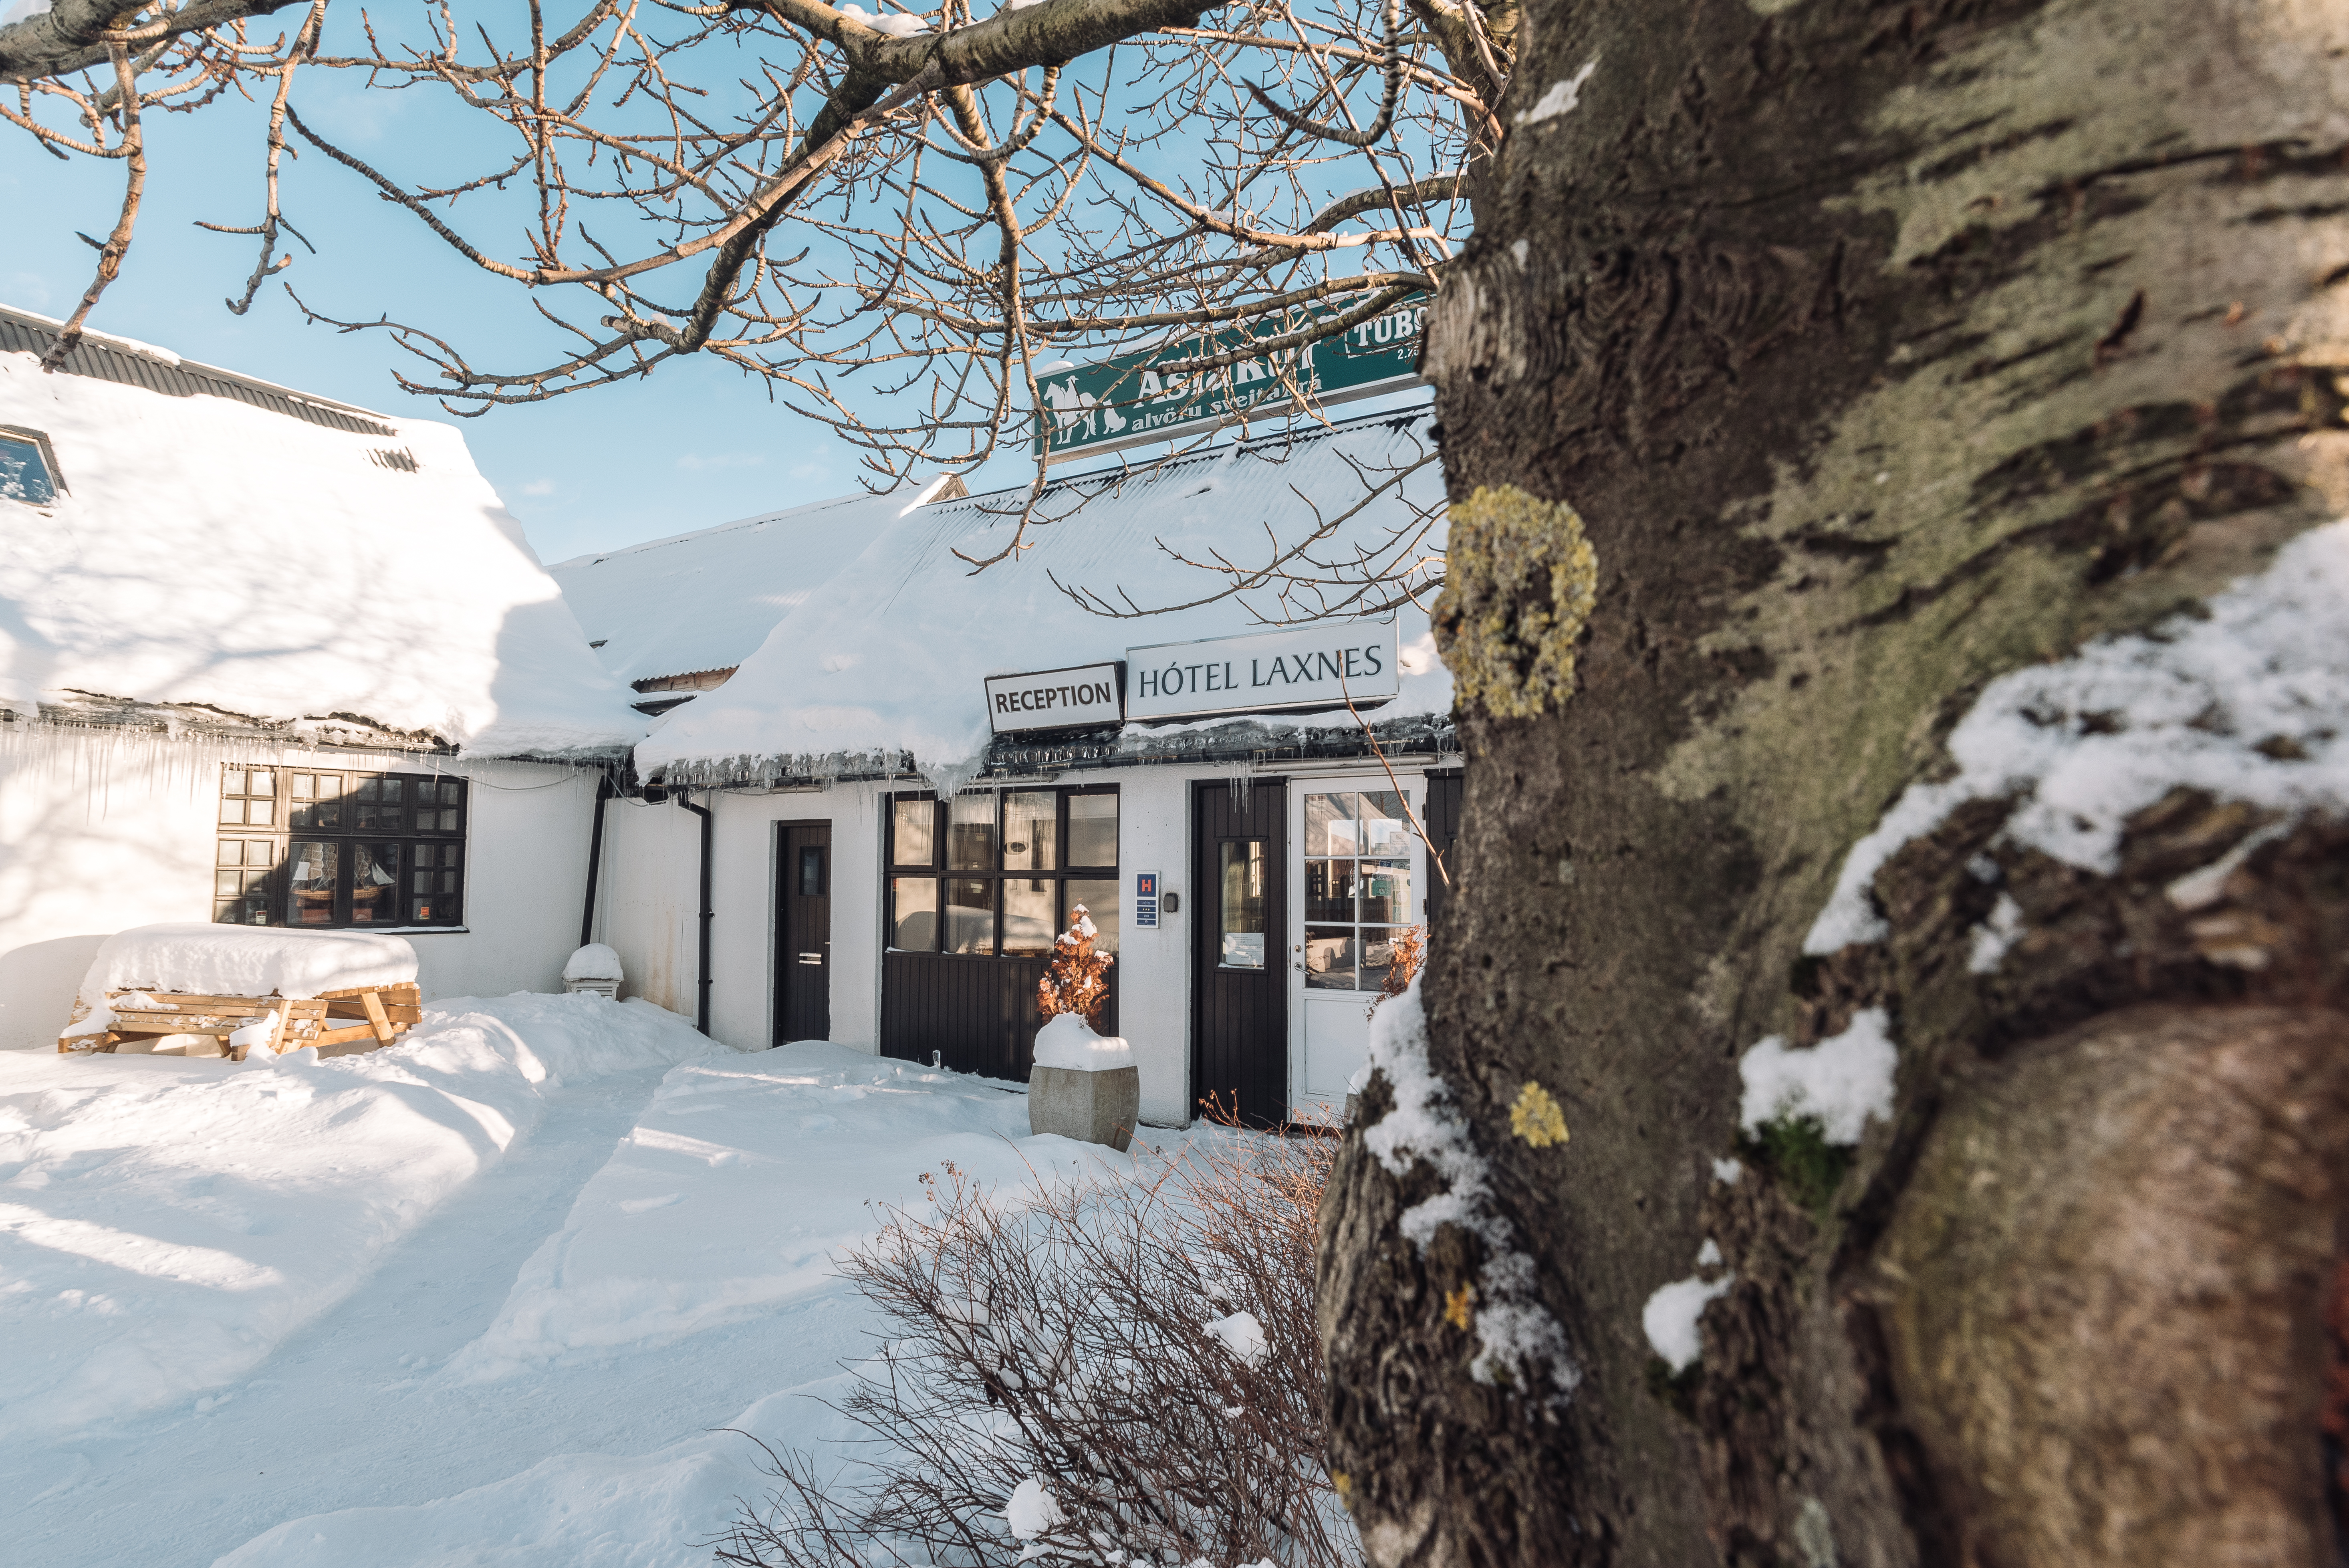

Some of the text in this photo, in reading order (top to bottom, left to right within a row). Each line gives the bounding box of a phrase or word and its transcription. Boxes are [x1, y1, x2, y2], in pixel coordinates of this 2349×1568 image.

[1131, 405, 1202, 431] alvöru
[1139, 645, 1382, 697] HÓTEL LAXNES
[995, 681, 1111, 714] RECEPTION
[1142, 879, 1151, 892] H
